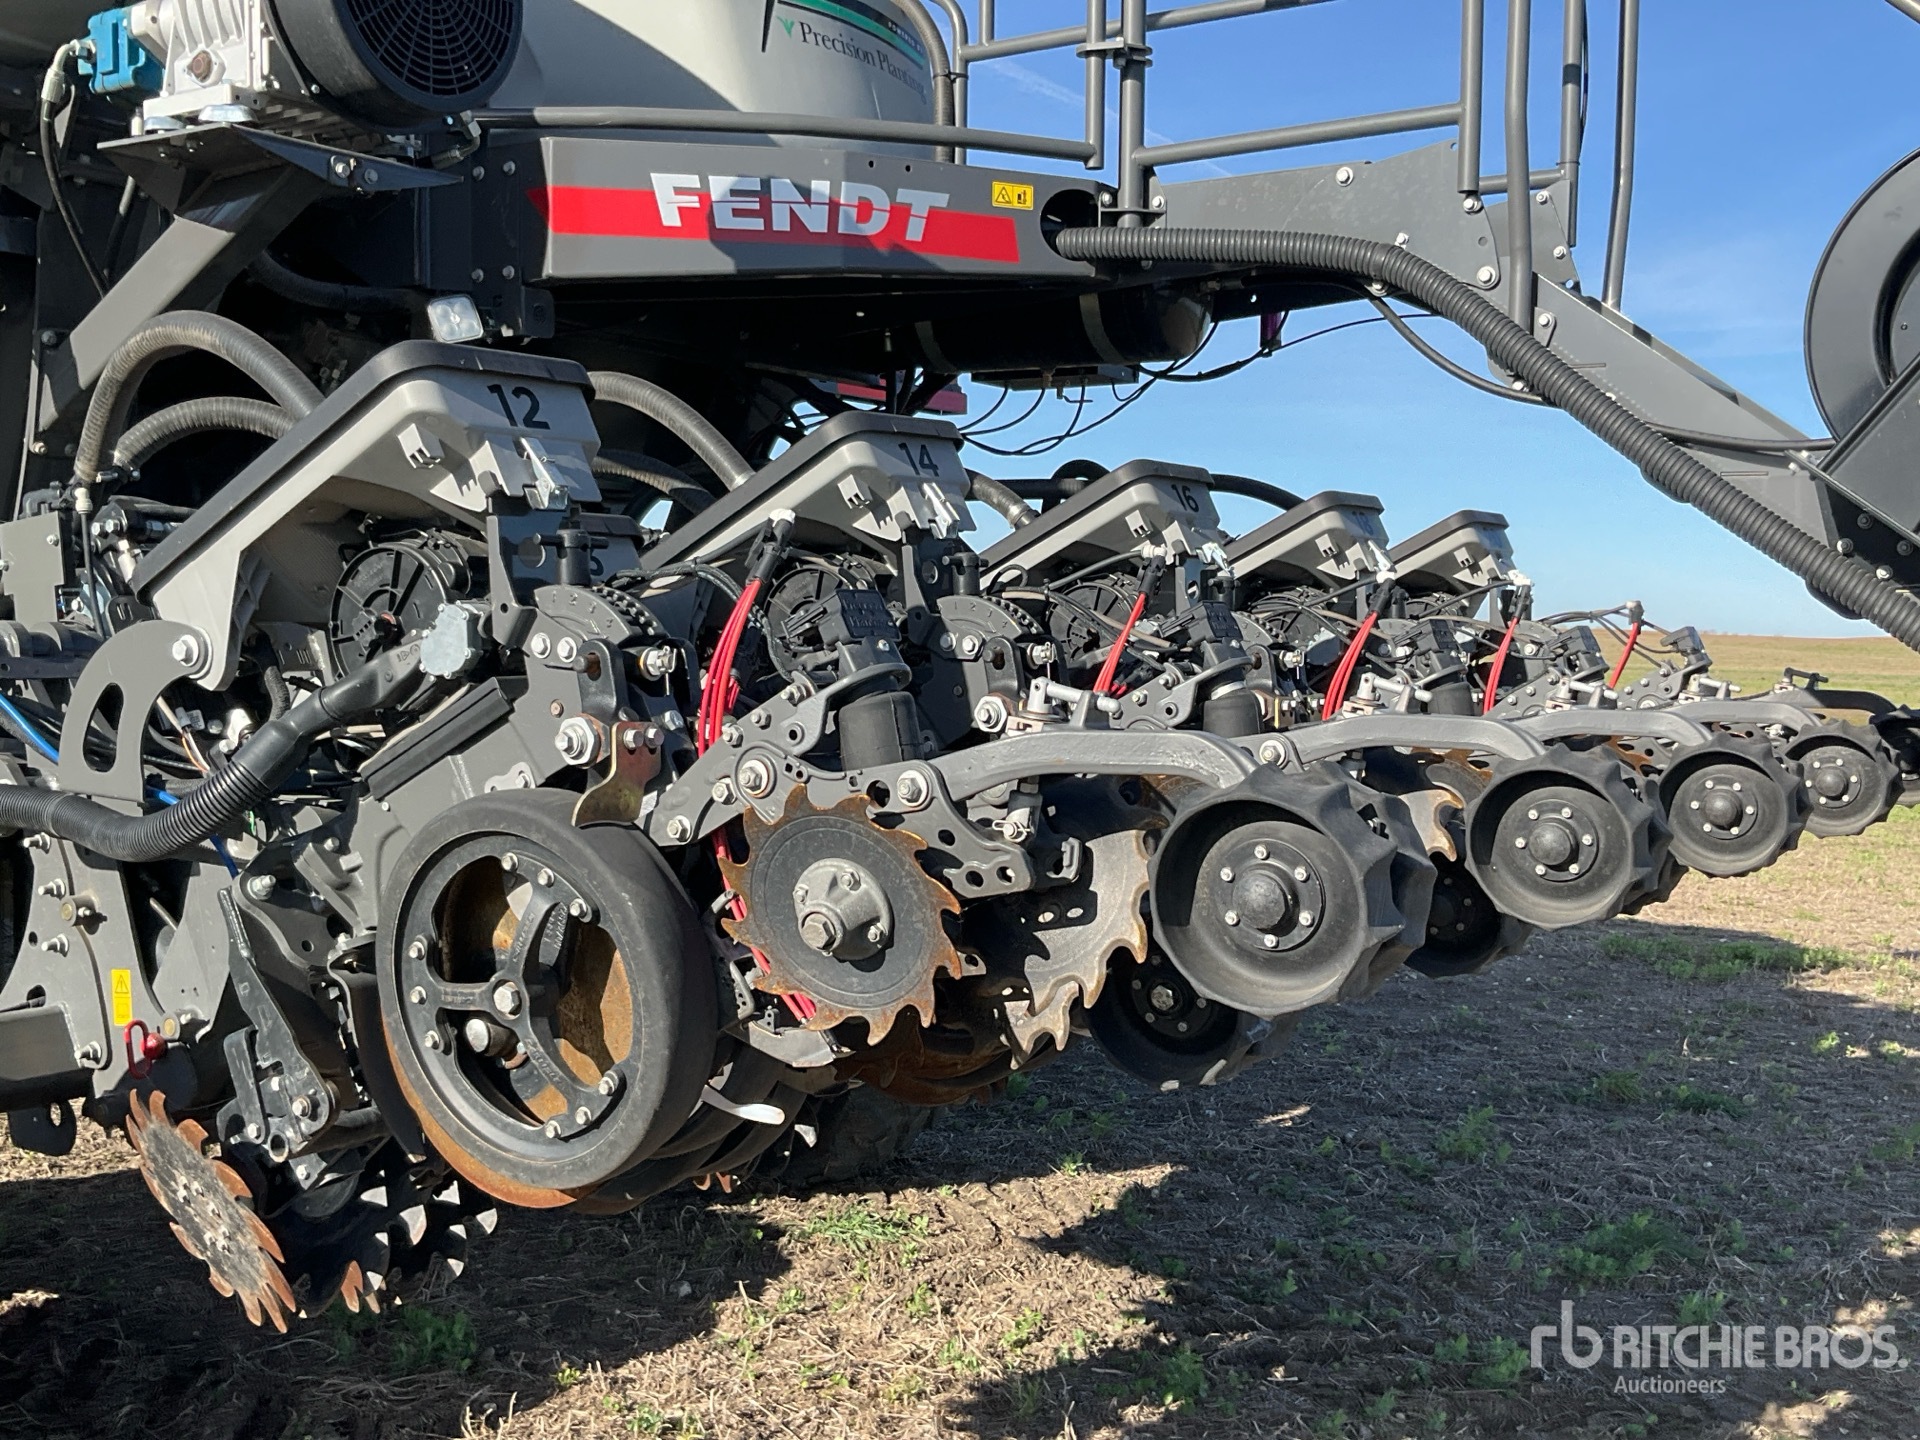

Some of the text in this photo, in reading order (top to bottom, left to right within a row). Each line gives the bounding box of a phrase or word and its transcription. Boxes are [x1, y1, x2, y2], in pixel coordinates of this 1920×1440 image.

[799, 21, 928, 105] Precision Planting
[650, 172, 950, 242] FENDT
[487, 384, 551, 430] 12
[898, 442, 940, 478] 14
[1171, 484, 1200, 513] 16
[1351, 510, 1374, 536] 18
